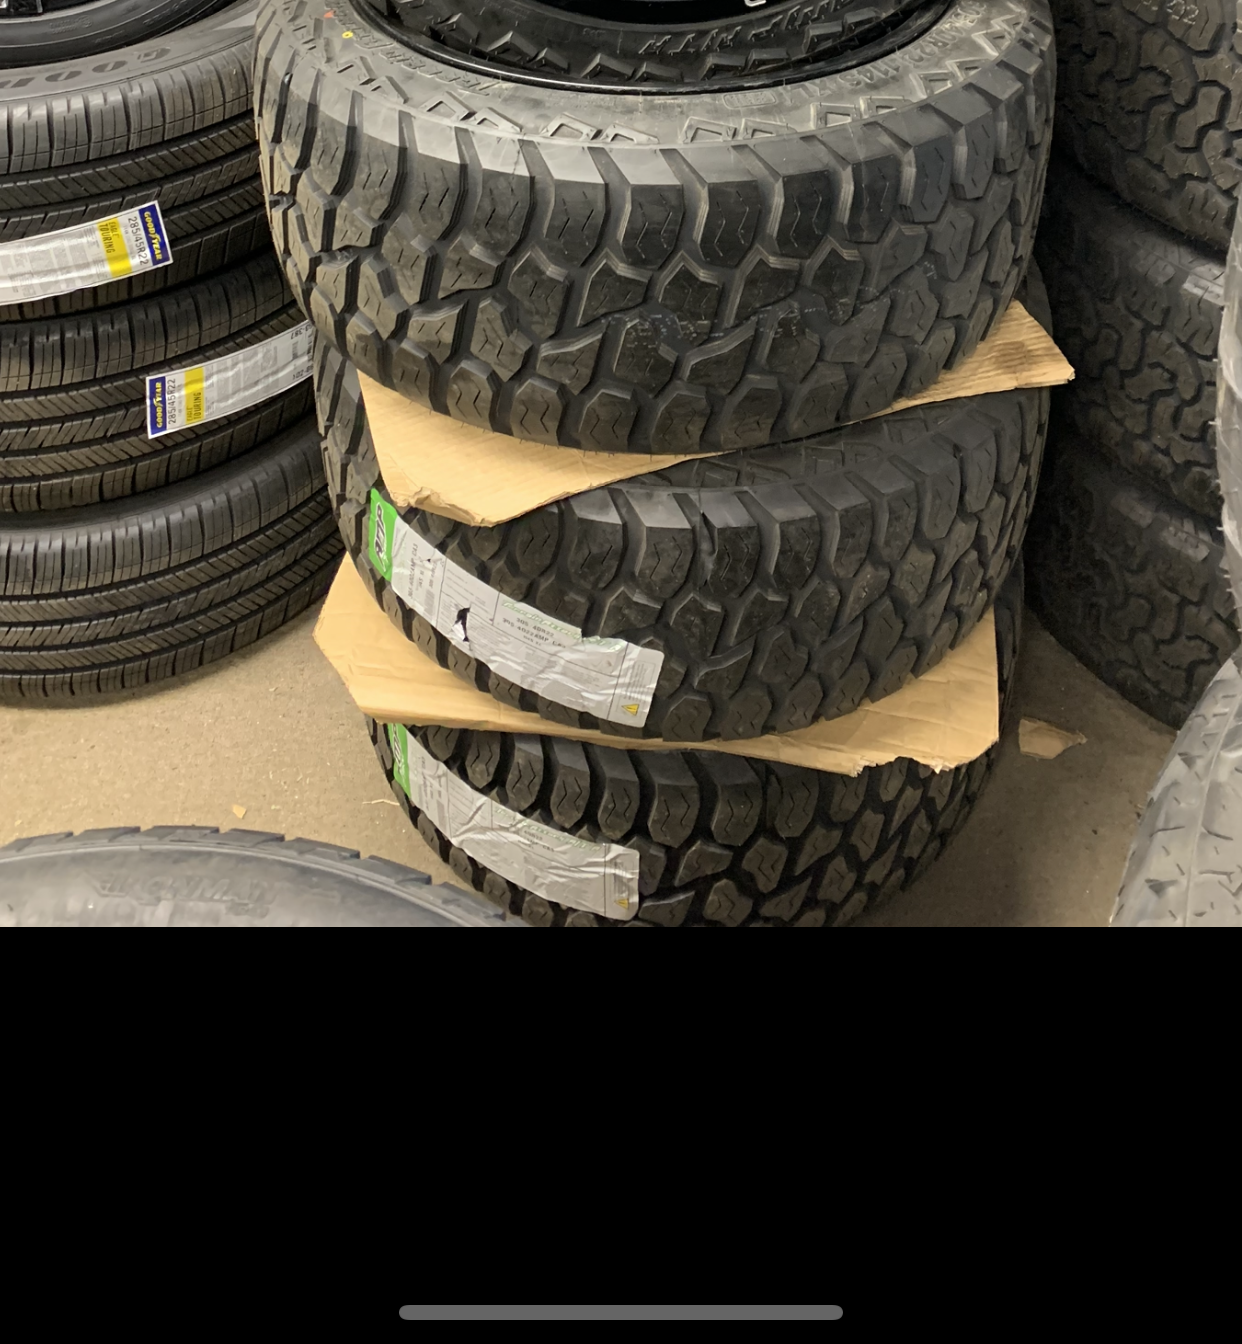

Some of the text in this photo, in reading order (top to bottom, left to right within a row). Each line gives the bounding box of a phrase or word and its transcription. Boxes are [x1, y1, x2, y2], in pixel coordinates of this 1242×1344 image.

[100, 224, 116, 253] TOURING
[128, 216, 149, 265] 285/45R22
[144, 211, 163, 261] GOODYEAR
[154, 382, 163, 429] GOODYEAR
[168, 378, 177, 425] 285/45R22
[193, 392, 202, 420] TOURING
